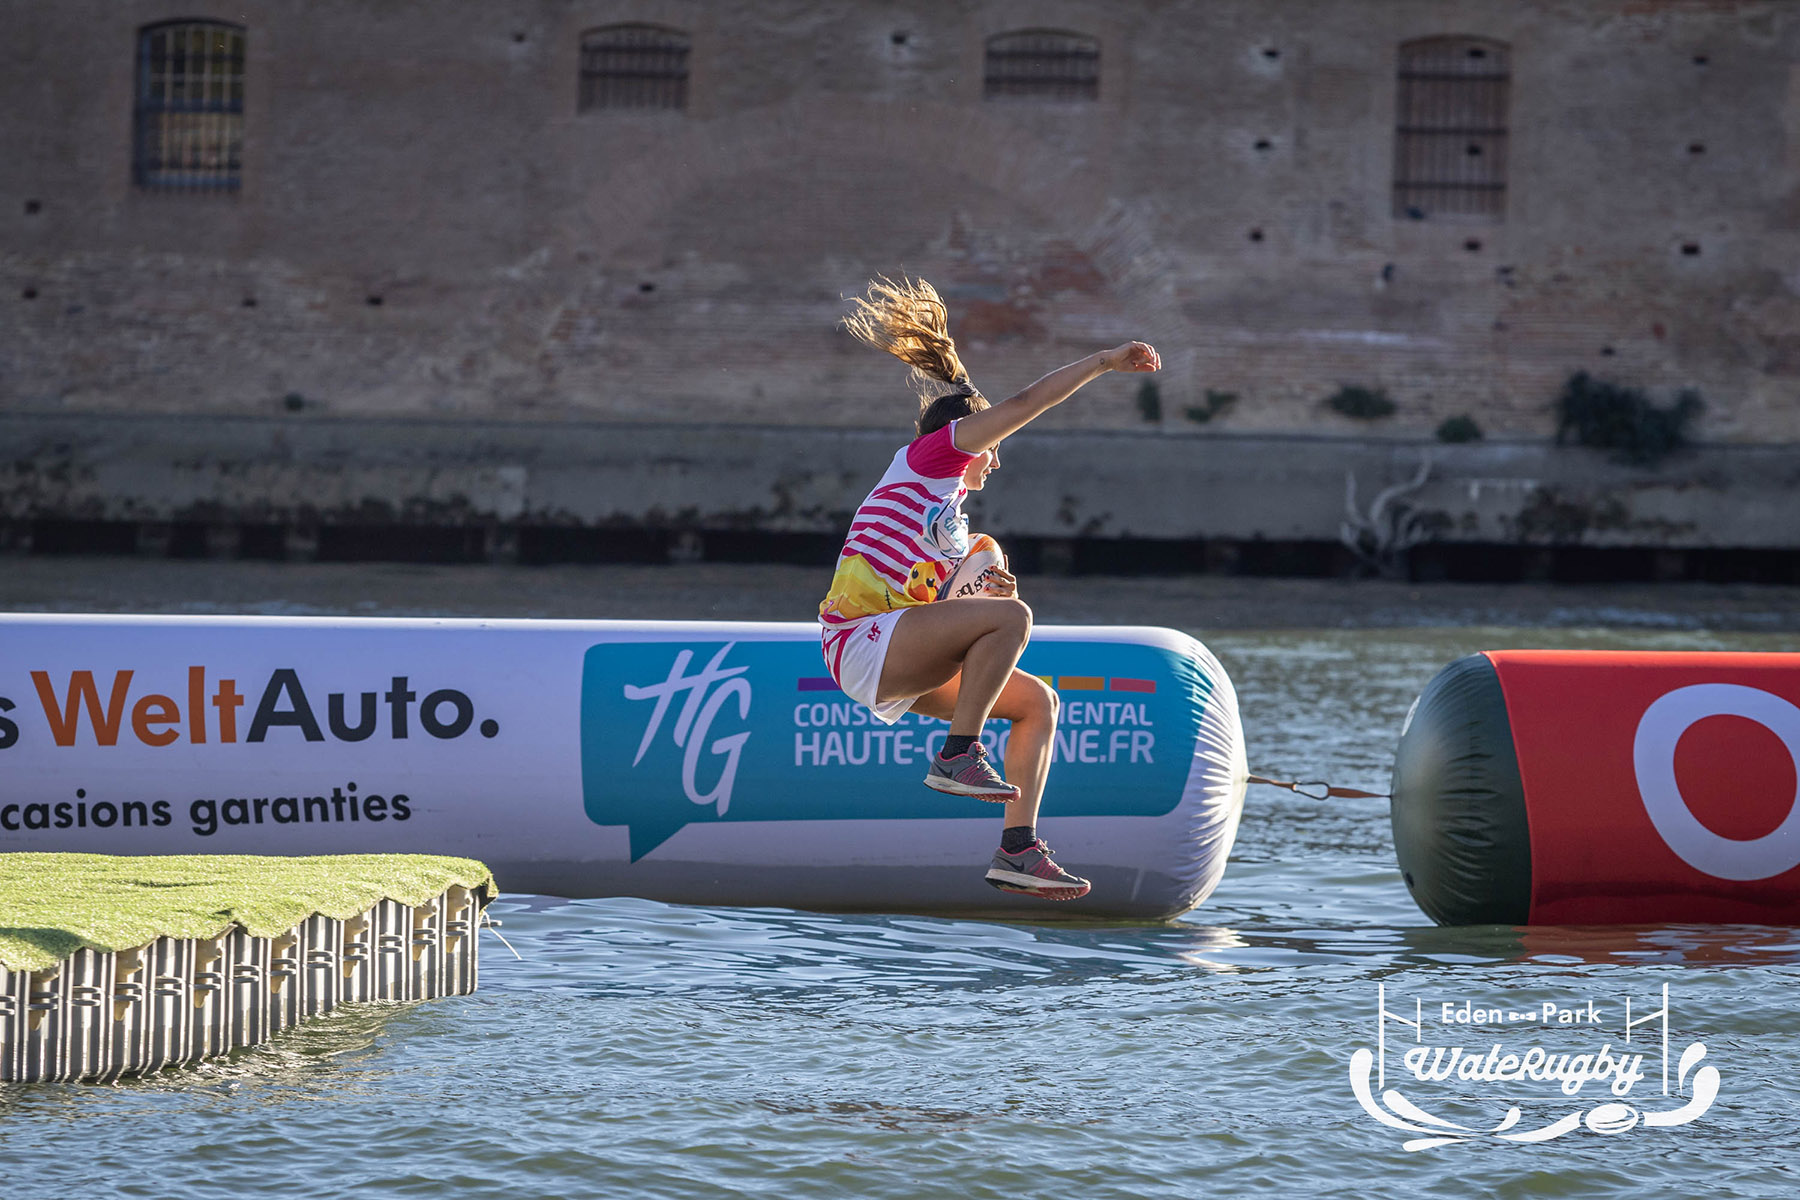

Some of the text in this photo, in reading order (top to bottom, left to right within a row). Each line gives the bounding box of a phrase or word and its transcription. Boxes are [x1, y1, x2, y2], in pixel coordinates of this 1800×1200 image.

[30, 666, 500, 747] WeltAuto.
[624, 641, 752, 817] HG
[190, 782, 412, 835] garanties
